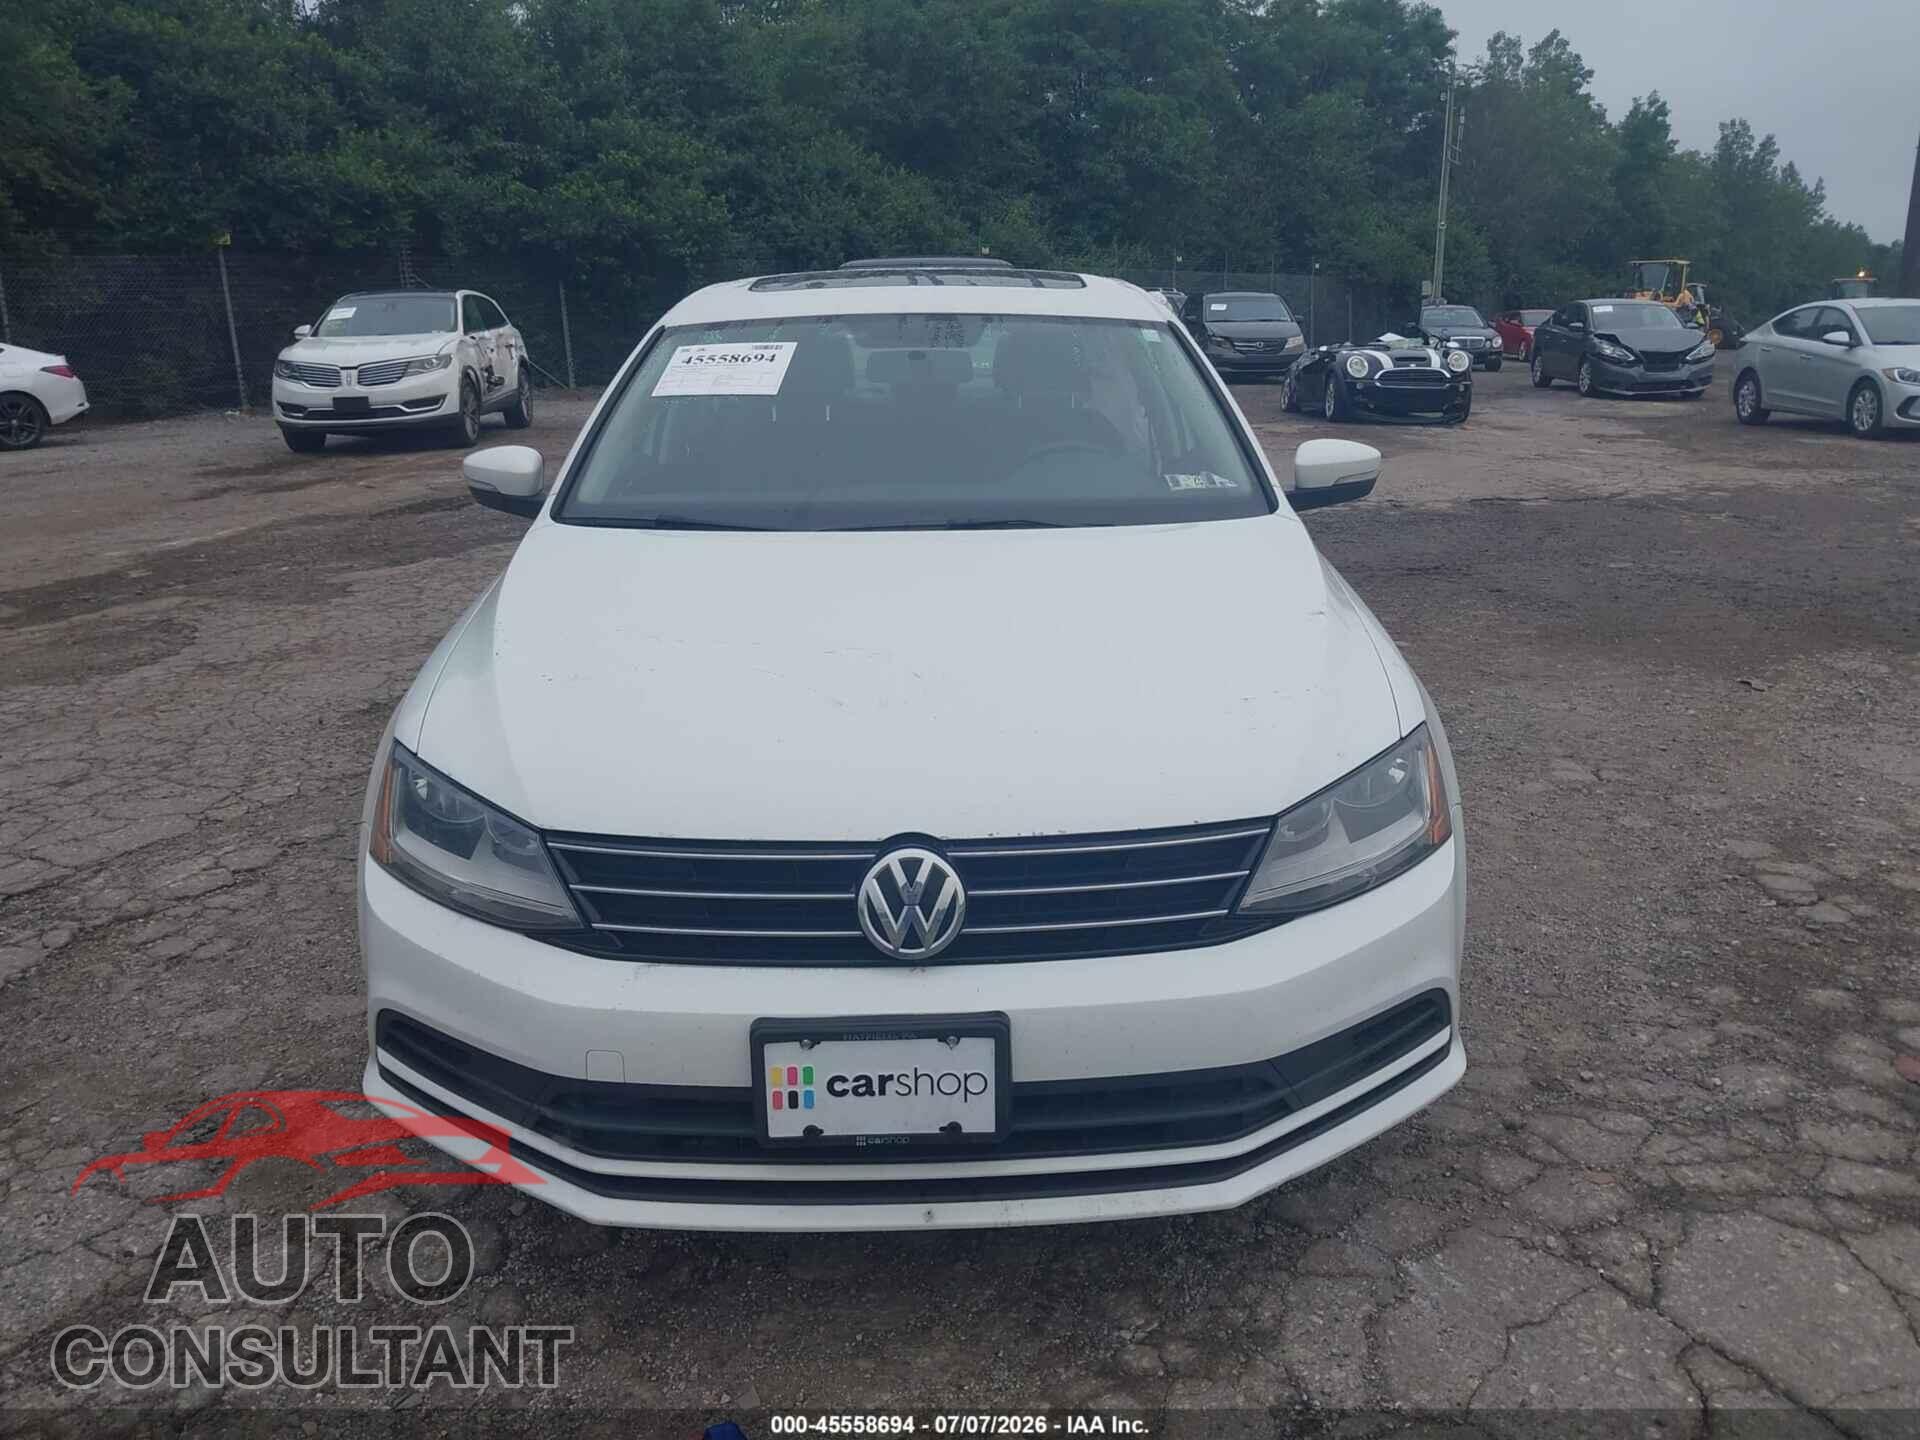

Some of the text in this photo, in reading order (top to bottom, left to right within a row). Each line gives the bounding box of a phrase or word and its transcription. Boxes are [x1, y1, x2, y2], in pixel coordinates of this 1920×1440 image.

[681, 353, 777, 365] 45558694
[858, 847, 967, 960] VW
[826, 1067, 988, 1103] carshop
